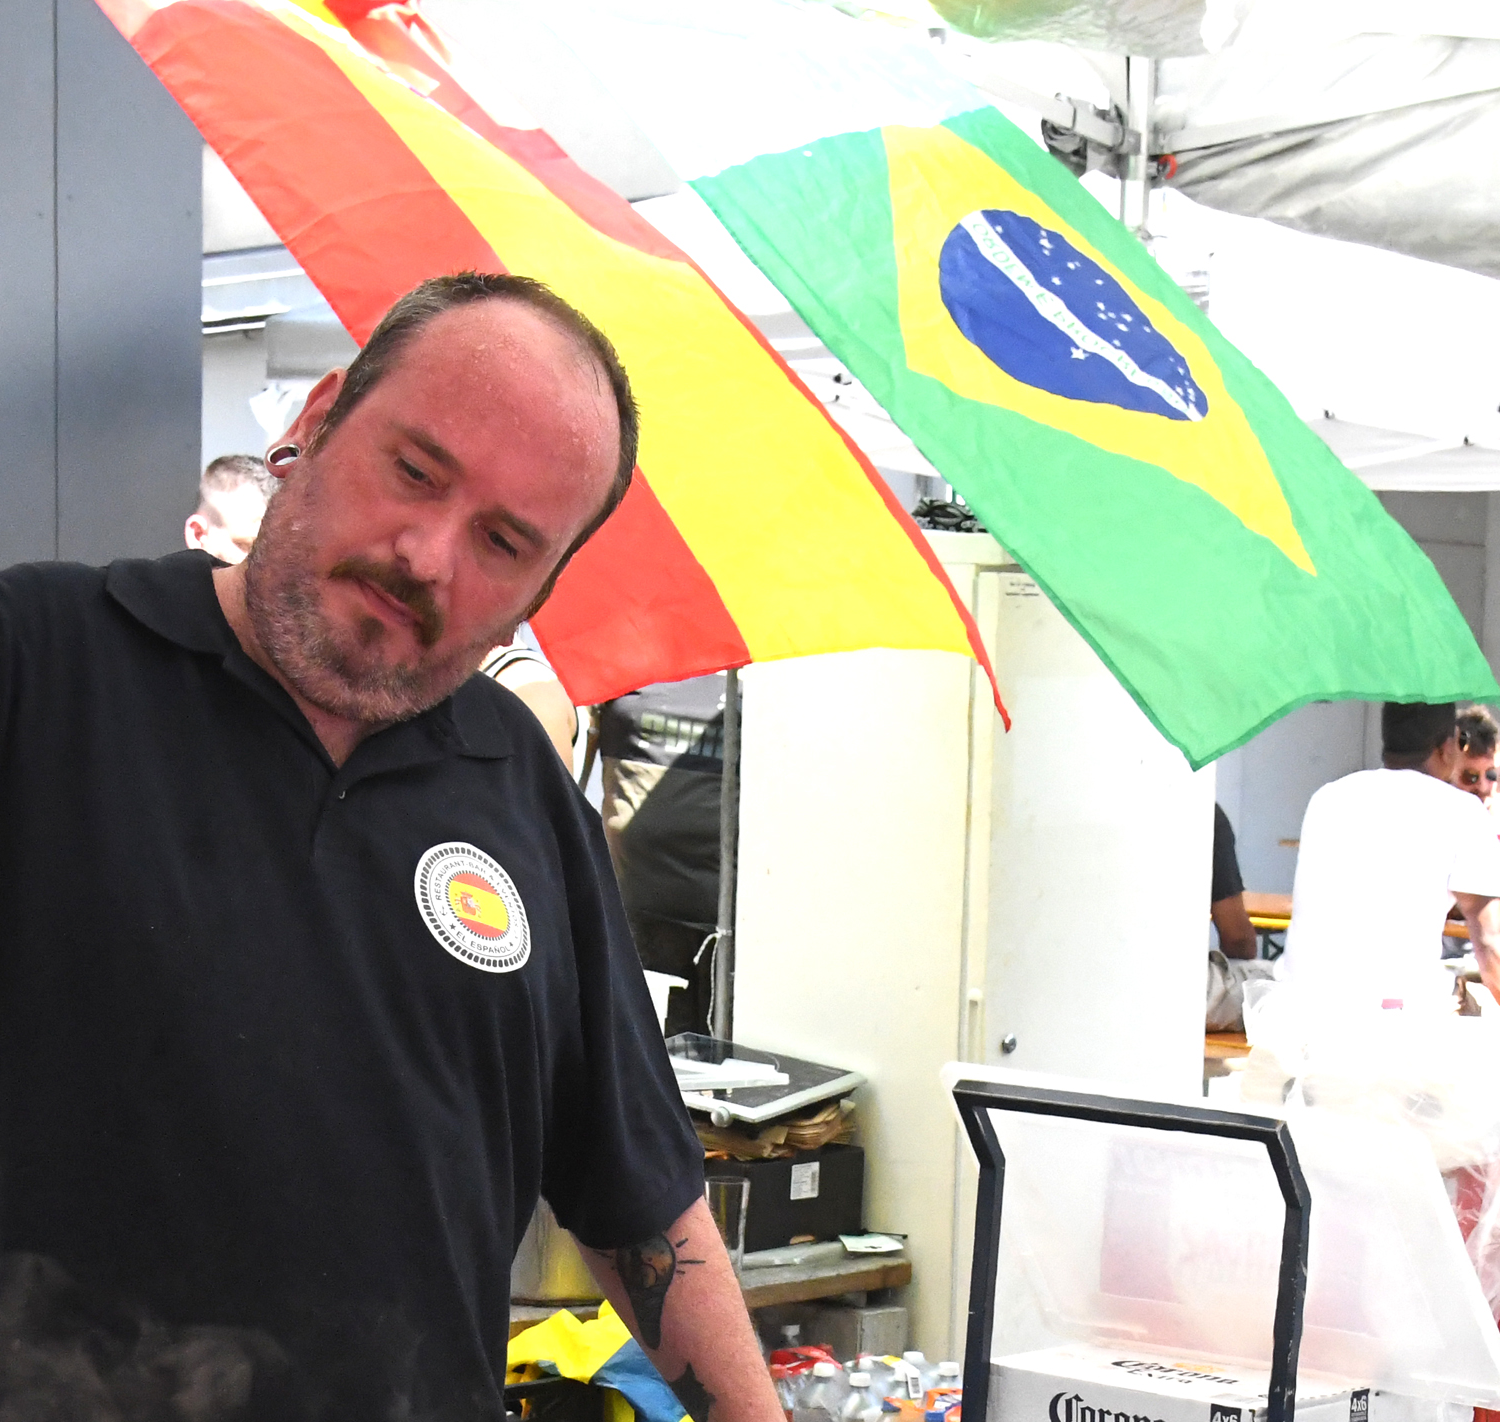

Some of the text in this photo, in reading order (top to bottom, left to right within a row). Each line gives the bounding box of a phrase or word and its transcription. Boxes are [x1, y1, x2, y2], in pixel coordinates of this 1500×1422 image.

[455, 931, 512, 955] EL ESPAÑOL
[1350, 1395, 1368, 1413] 4x6
